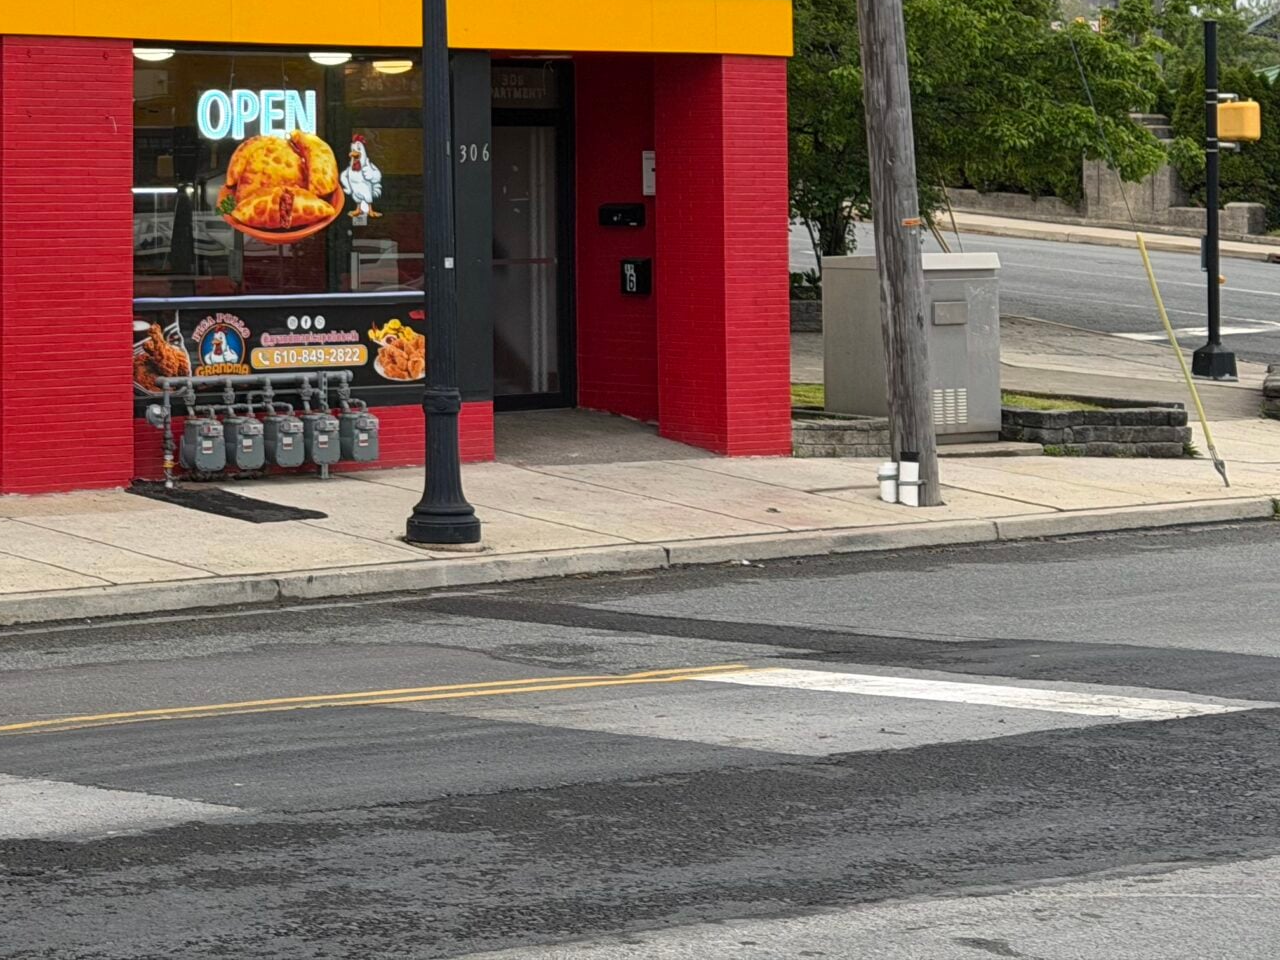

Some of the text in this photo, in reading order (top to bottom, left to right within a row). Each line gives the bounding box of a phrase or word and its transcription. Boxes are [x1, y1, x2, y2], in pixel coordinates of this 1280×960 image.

[197, 89, 316, 141] OPEN
[459, 143, 490, 163] 306
[273, 347, 360, 364] 610-849-2822
[195, 362, 250, 377] GRANDMA
